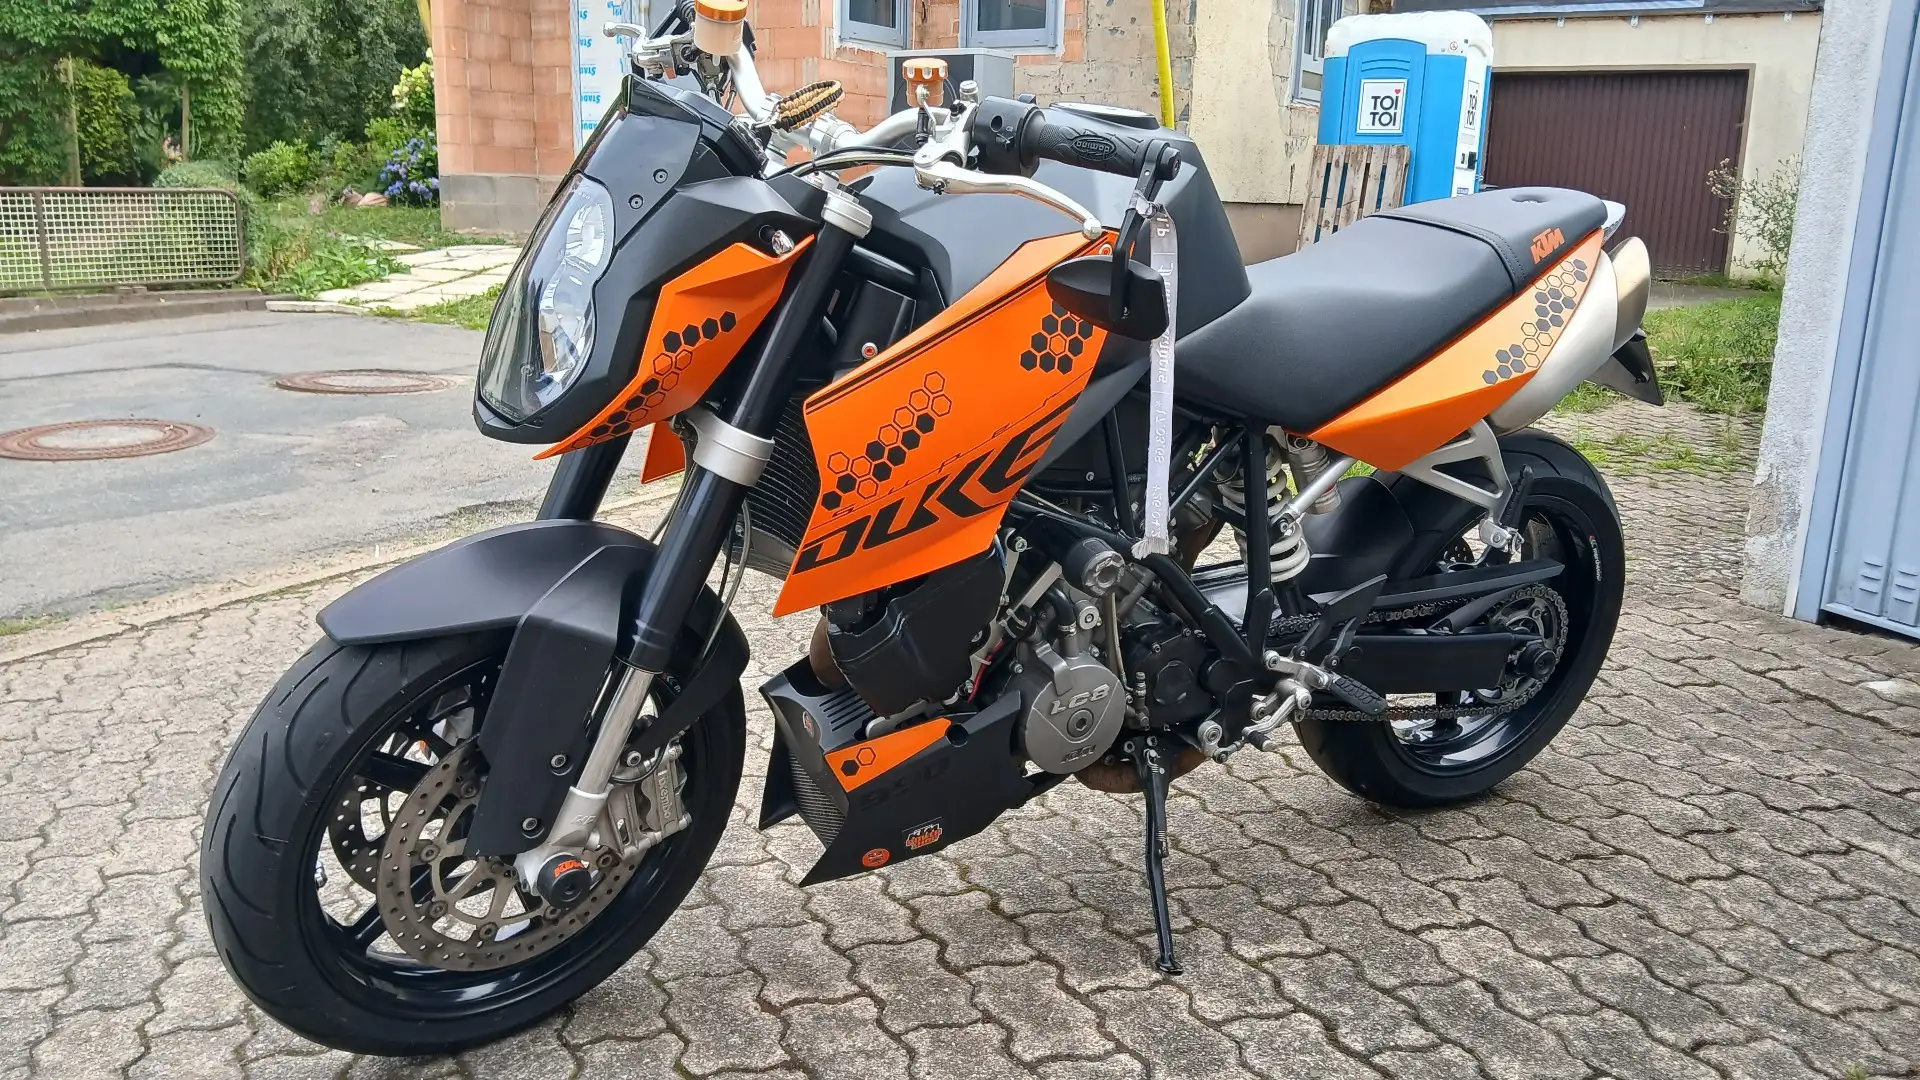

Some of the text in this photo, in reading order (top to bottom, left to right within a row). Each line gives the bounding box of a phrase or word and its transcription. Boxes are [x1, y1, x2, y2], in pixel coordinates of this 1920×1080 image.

[1371, 95, 1399, 110] TOI
[1369, 111, 1397, 126] TOI
[1076, 140, 1111, 160] domino
[1530, 227, 1565, 264] KTM
[793, 387, 1086, 576] DUKE
[659, 776, 673, 819] brembo
